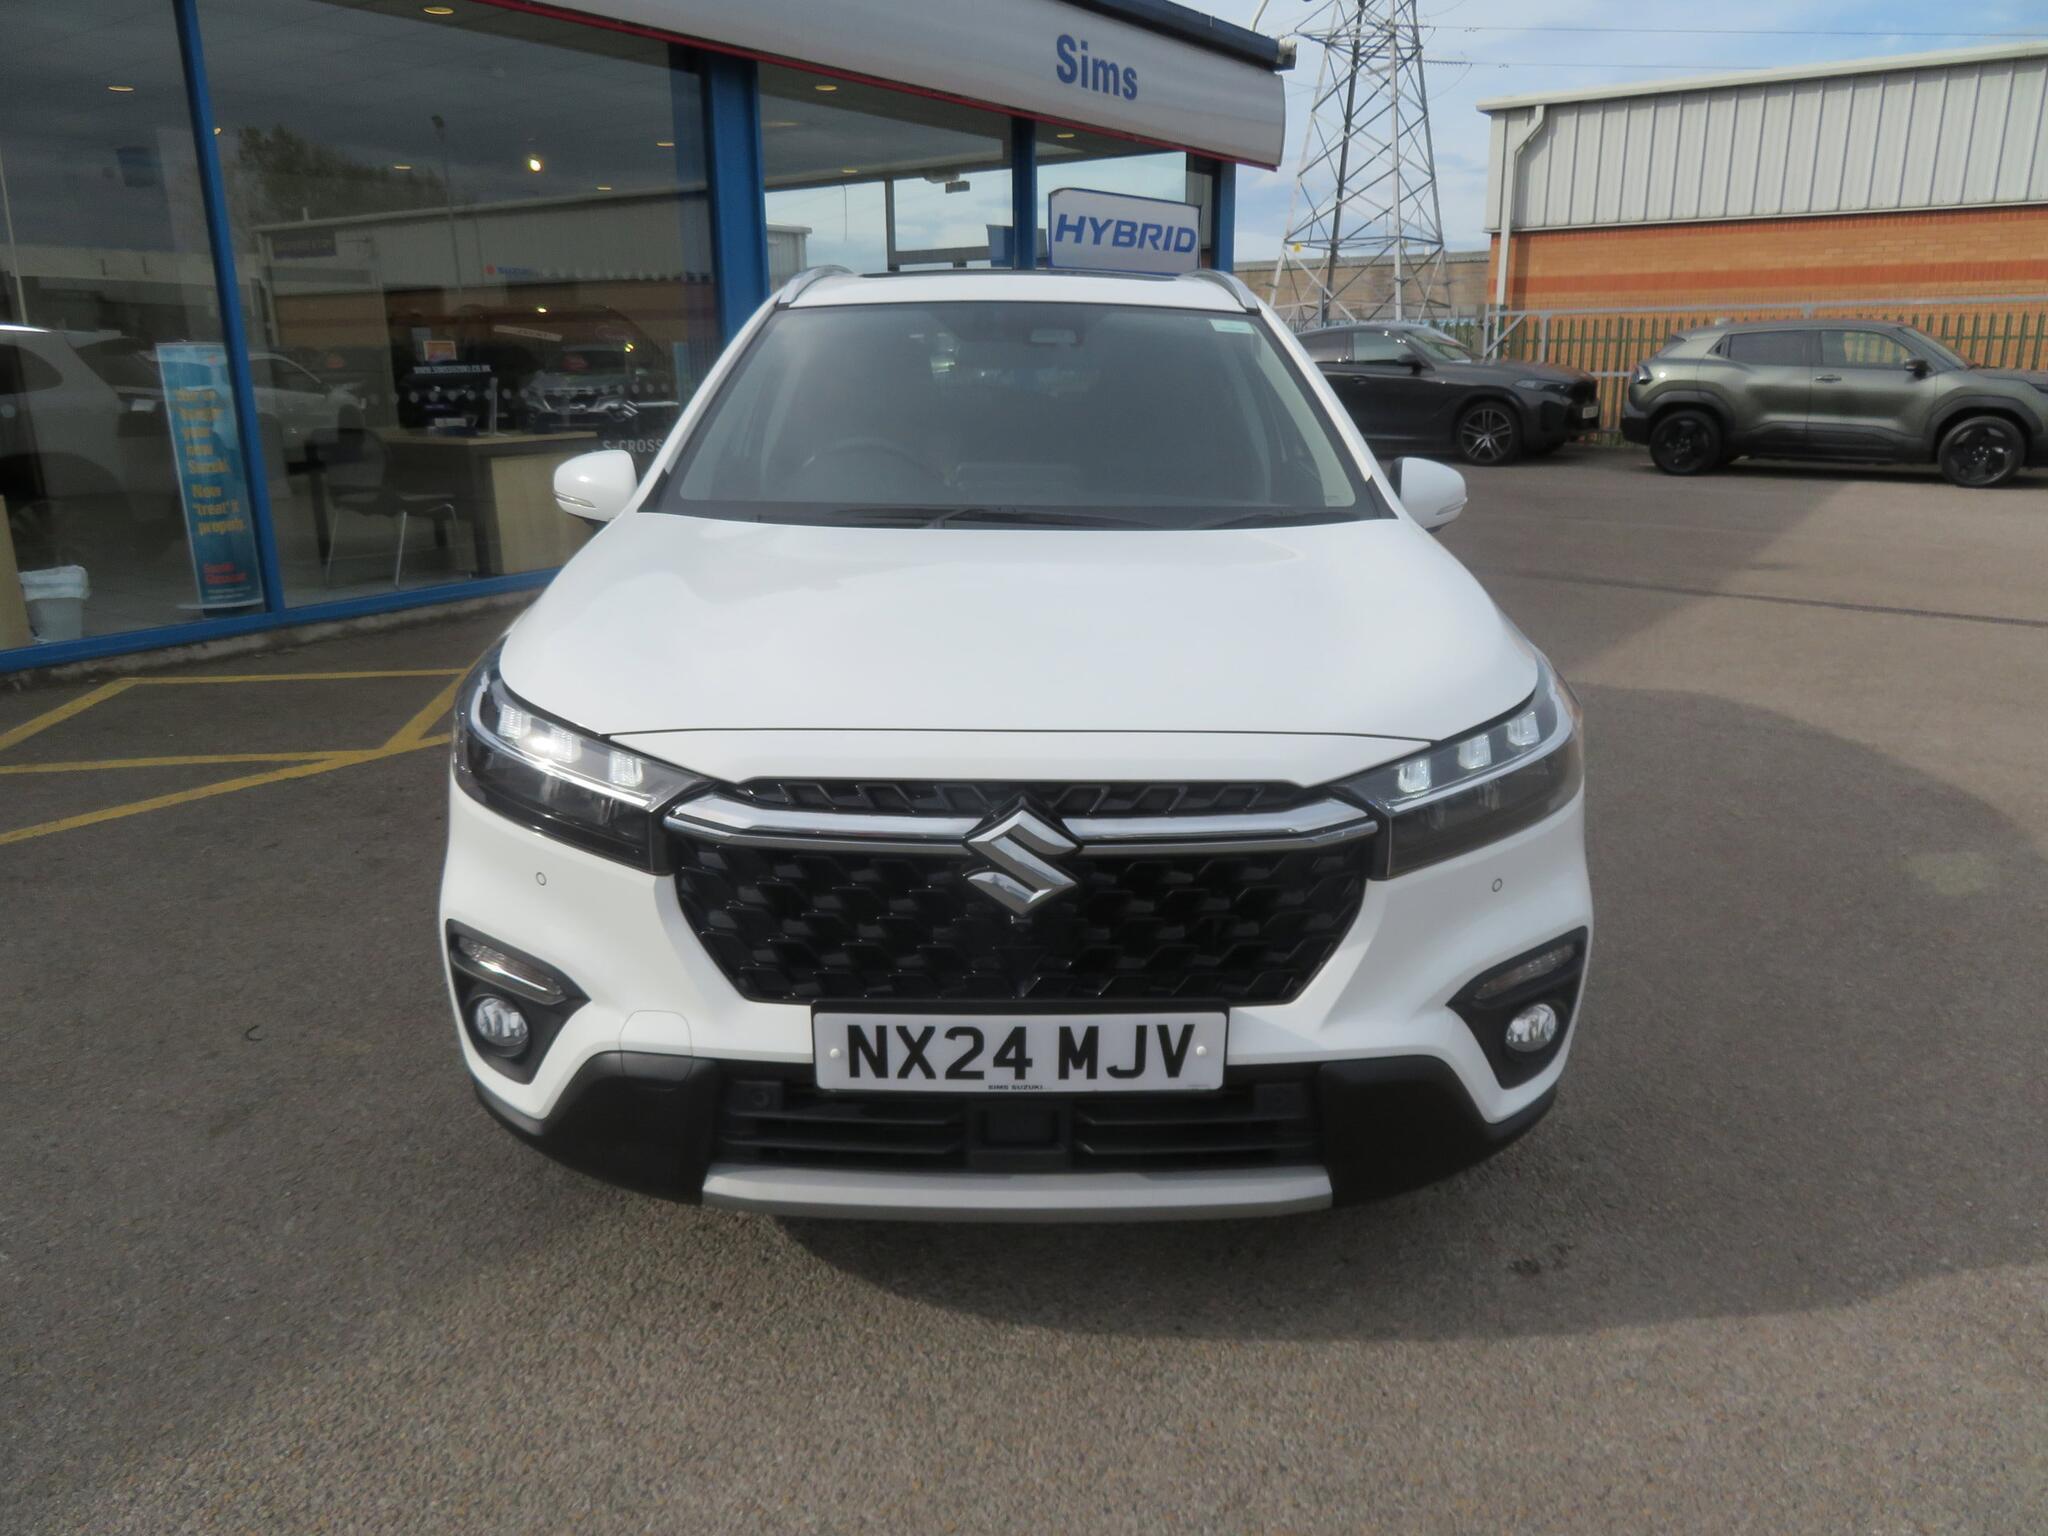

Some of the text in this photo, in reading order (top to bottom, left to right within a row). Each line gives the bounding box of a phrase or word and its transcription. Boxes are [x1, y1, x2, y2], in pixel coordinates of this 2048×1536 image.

[1056, 34, 1138, 100] Sims
[1055, 214, 1197, 253] HYBRID
[847, 1023, 1196, 1081] NX24 MJV
